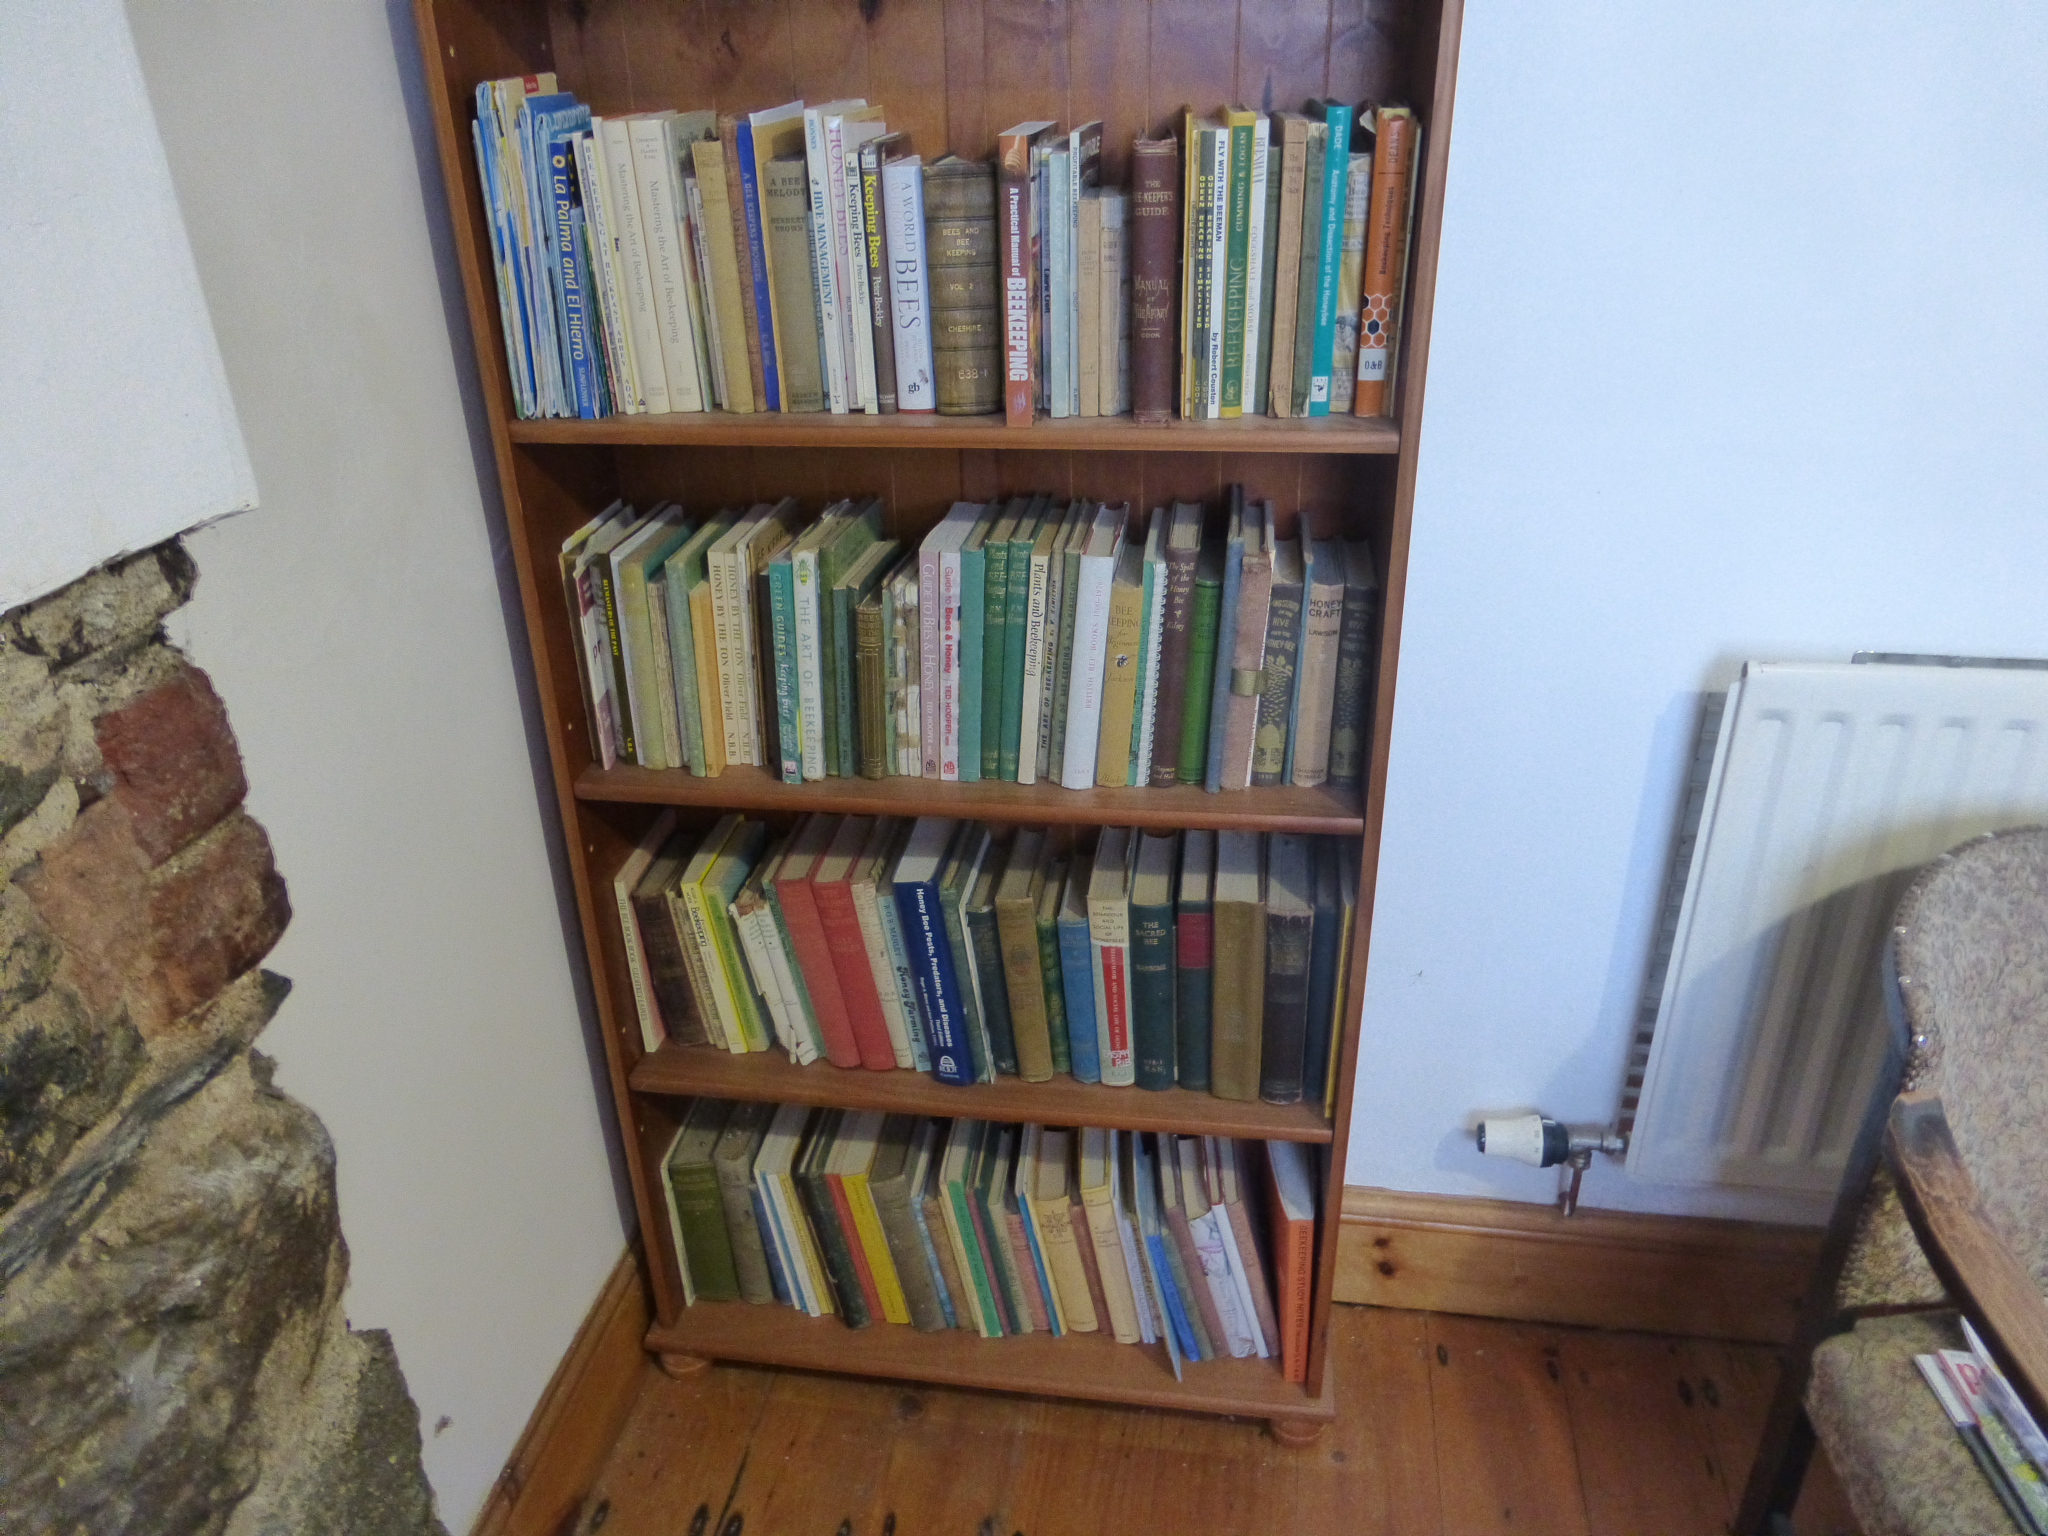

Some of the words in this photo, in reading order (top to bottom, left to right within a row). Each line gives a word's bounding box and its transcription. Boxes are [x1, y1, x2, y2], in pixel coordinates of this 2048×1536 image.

[1239, 132, 1247, 169] LOGAN
[1334, 126, 1343, 149] DADE
[830, 129, 846, 199] HONEY
[553, 175, 567, 194] La
[618, 164, 631, 211] Mastering
[766, 187, 806, 197] MELODY
[770, 178, 777, 186] A
[781, 177, 800, 186] BEE
[902, 182, 910, 191] A
[1198, 176, 1206, 208] QUEEN
[1206, 176, 1214, 208] QUEEN
[1328, 169, 1340, 204] Anatomy
[649, 180, 664, 233] Mastering
[813, 190, 825, 219] HIVE
[848, 183, 861, 230] Keeping
[862, 174, 879, 233] Keeping
[1009, 195, 1020, 233] Practical
[1135, 207, 1169, 216] GUIDE
[1235, 183, 1244, 231] CUMMING
[1328, 207, 1338, 221] and
[556, 200, 573, 252] Palma
[627, 213, 637, 228] the
[836, 210, 849, 256] BEES
[902, 196, 916, 252] WORLD
[943, 227, 962, 236] BEES
[965, 226, 980, 235] AND
[1215, 204, 1223, 242] BEEMAN
[629, 230, 638, 246] Art
[657, 236, 667, 252] the
[853, 232, 864, 258] Bees
[956, 237, 971, 246] BEE
[1010, 235, 1021, 264] Manual
[1197, 215, 1205, 259] REARING
[1205, 215, 1213, 259] REARING
[1324, 224, 1335, 262] Dissection
[631, 248, 640, 258] of
[660, 255, 670, 271] Art
[815, 223, 833, 306] MANAGEMENT
[868, 236, 881, 268] Bees
[946, 248, 977, 258] KEEPING
[1378, 232, 1391, 275] Beekeeping
[563, 258, 578, 289] and
[663, 273, 674, 284] of
[1011, 267, 1021, 276] of
[1043, 268, 1051, 292] Laurie
[1324, 265, 1333, 274] of
[1324, 276, 1332, 288] the
[632, 261, 647, 312] Beekeeping
[873, 276, 882, 296] Peter
[895, 259, 920, 330] BEES
[1196, 266, 1205, 329] SIMPLIFIED
[1204, 266, 1212, 329] SIMPLIFIED
[568, 295, 582, 309] El
[665, 287, 680, 344] Beekeeping
[874, 297, 884, 327] Beckley
[1043, 294, 1051, 314] Croft
[1226, 257, 1245, 367] BEEKEEPING
[1319, 290, 1331, 326] Honeybee
[948, 324, 983, 333] CHESHIRE
[1007, 277, 1028, 381] BEEKEEPING
[1246, 303, 1254, 335] MORSE
[569, 313, 584, 360] Hierro
[1211, 333, 1219, 342] by
[1211, 344, 1219, 371] Robert
[578, 367, 589, 407] SUNFLOWER
[908, 382, 920, 394] gb
[1210, 373, 1218, 405] Couston
[713, 565, 722, 601] HONEY
[728, 565, 737, 600] HONEY
[774, 573, 784, 611] GREEN
[922, 564, 935, 598] GUIDE
[945, 567, 954, 594] Guide
[1032, 564, 1044, 596] Plants
[1170, 585, 1189, 595] Honey
[716, 605, 725, 618] BY
[731, 605, 740, 617] BY
[800, 597, 810, 625] THE
[923, 601, 933, 614] TO
[945, 596, 952, 605] to
[1031, 599, 1043, 617] and
[1115, 605, 1134, 616] BEE
[1309, 599, 1343, 609] HONEY
[1309, 608, 1341, 619] CRAFT
[718, 622, 727, 643] THE
[732, 622, 741, 643] THE
[923, 617, 935, 640] BEES
[945, 607, 953, 631] Bees
[1272, 618, 1290, 628] HIVE
[776, 616, 786, 656] GUIDES
[1089, 623, 1099, 651] BOOKS
[1308, 629, 1338, 637] LAWSON
[720, 647, 729, 666] TON
[734, 647, 743, 666] TON
[801, 634, 812, 660] ART
[924, 643, 934, 651] &
[943, 644, 953, 674] Honey
[1025, 621, 1041, 676] Beekeeping
[803, 670, 813, 687] OF
[924, 655, 936, 693] HONEY
[1045, 641, 1054, 691] BEE-KEEPING
[722, 673, 732, 697] Oliver
[736, 673, 745, 697] Oliver
[1085, 677, 1094, 709] BRITISH
[724, 701, 733, 720] Field
[739, 701, 747, 720] Field
[1044, 697, 1050, 707] OF
[805, 698, 817, 774] BEEKEEPING
[916, 888, 927, 913] Honey
[691, 907, 707, 946] Beekeeping
[921, 916, 929, 931] Bee
[623, 926, 632, 944] BOOK
[628, 946, 636, 964] BOOK
[889, 927, 901, 957] MANLEY
[925, 932, 935, 956] Pests,
[930, 958, 943, 998] Predators,
[895, 966, 911, 999] Honey
[903, 1001, 921, 1043] Farming
[938, 999, 947, 1013] and
[941, 1014, 954, 1047] Diseases
[1298, 1225, 1308, 1274] BEEKEEPING
[1297, 1277, 1305, 1301] STUDY
[1296, 1303, 1304, 1328] NOTES
